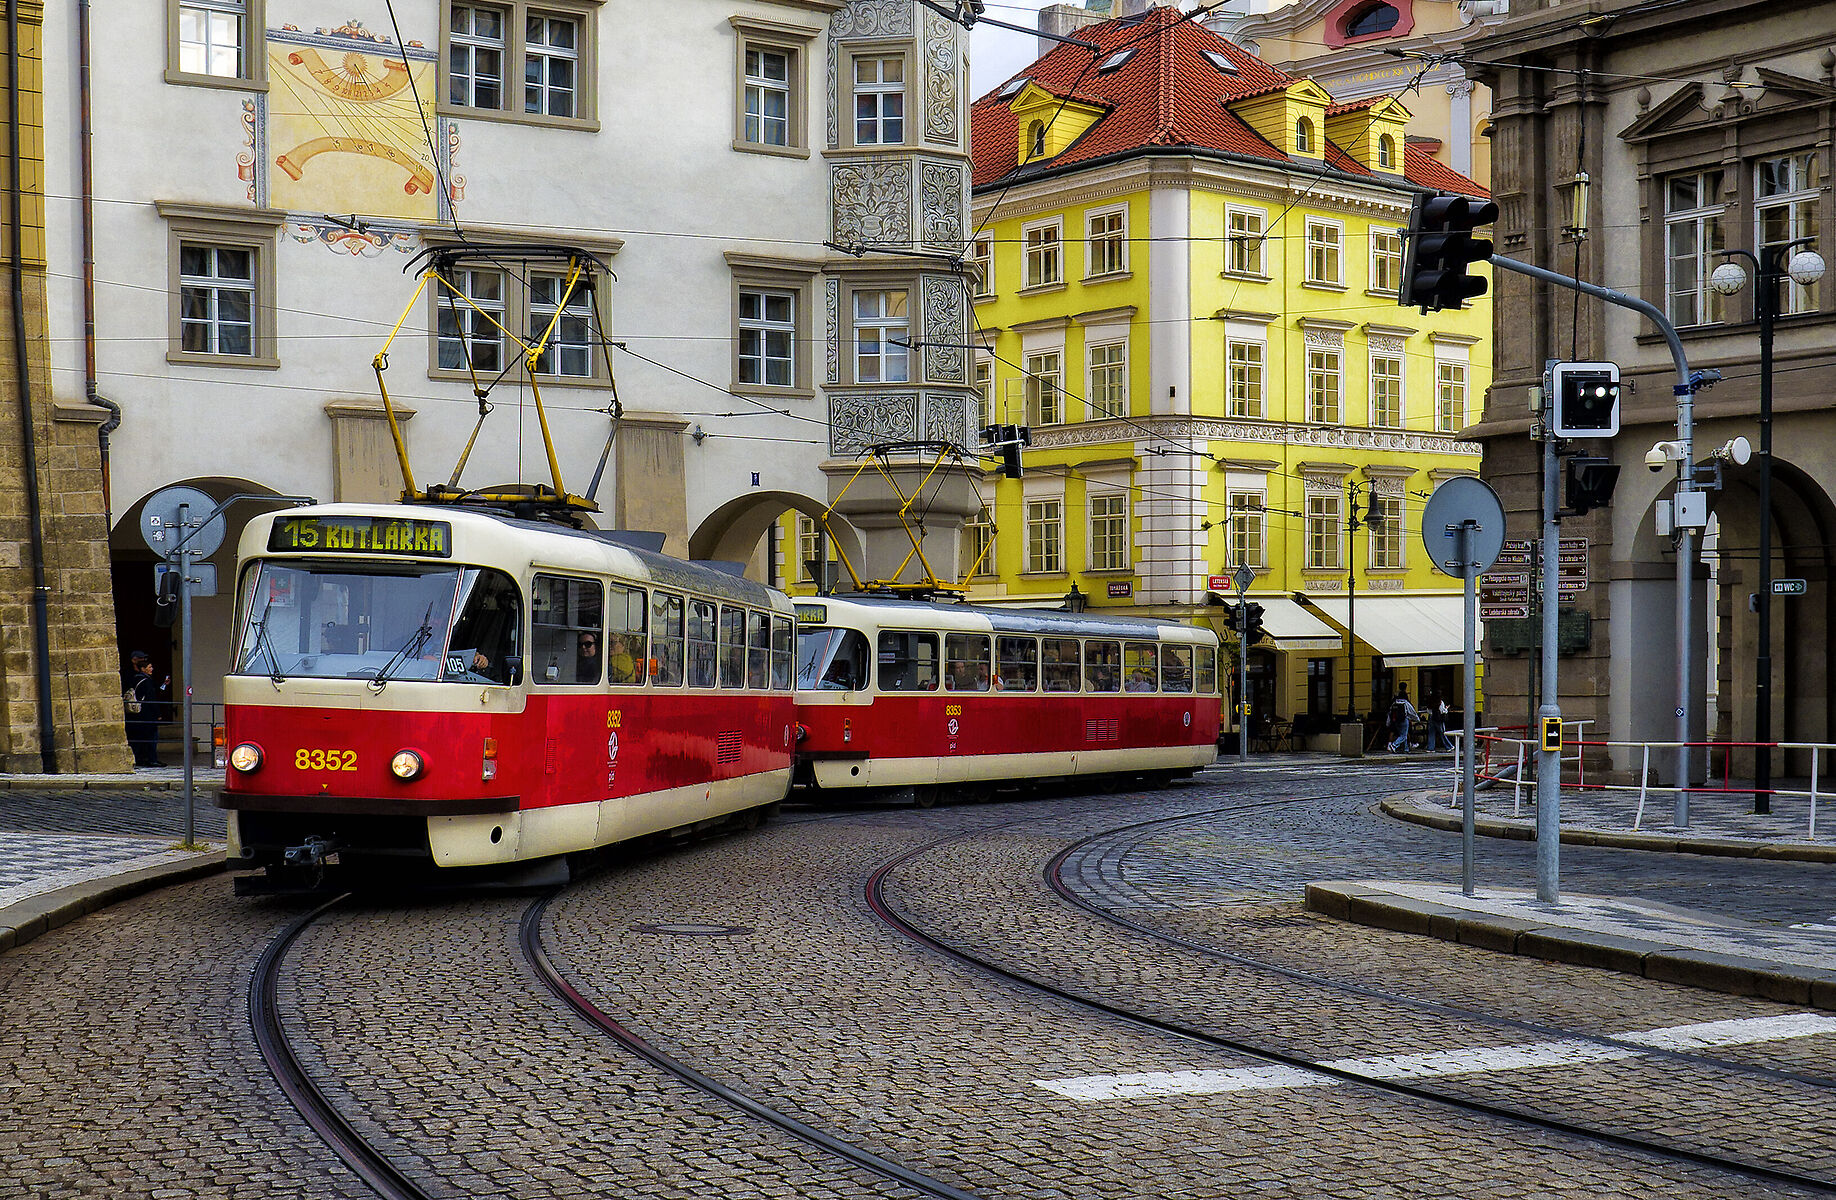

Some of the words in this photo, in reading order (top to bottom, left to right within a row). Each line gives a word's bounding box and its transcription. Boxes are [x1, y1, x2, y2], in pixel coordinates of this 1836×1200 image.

[421, 153, 430, 162] 20
[284, 519, 320, 547] 15
[1784, 583, 1795, 591] WC
[446, 657, 465, 673] 105
[946, 705, 961, 715] 8353
[606, 709, 621, 728] 8352
[295, 748, 358, 771] 8352
